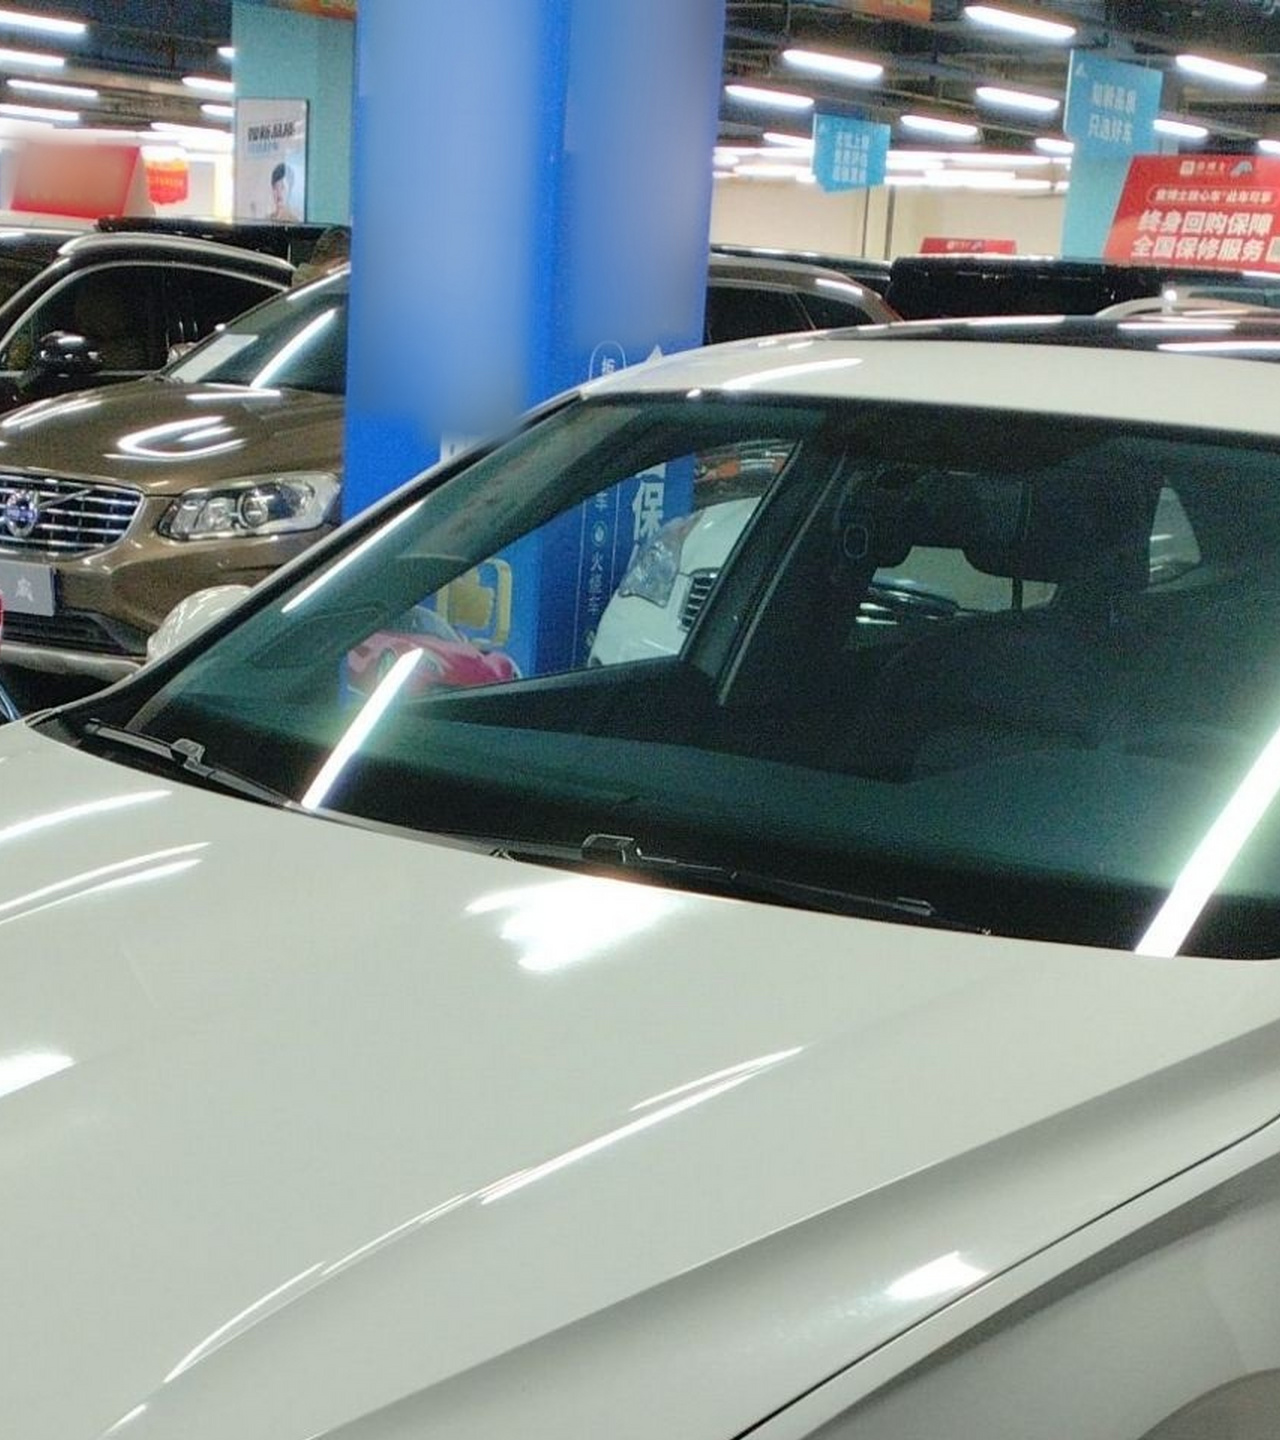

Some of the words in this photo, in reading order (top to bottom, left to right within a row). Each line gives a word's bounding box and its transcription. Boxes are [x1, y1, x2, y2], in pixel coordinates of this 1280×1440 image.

[1137, 209, 1274, 236] 终身回购保障
[1130, 234, 1265, 263] 全国保修服务
